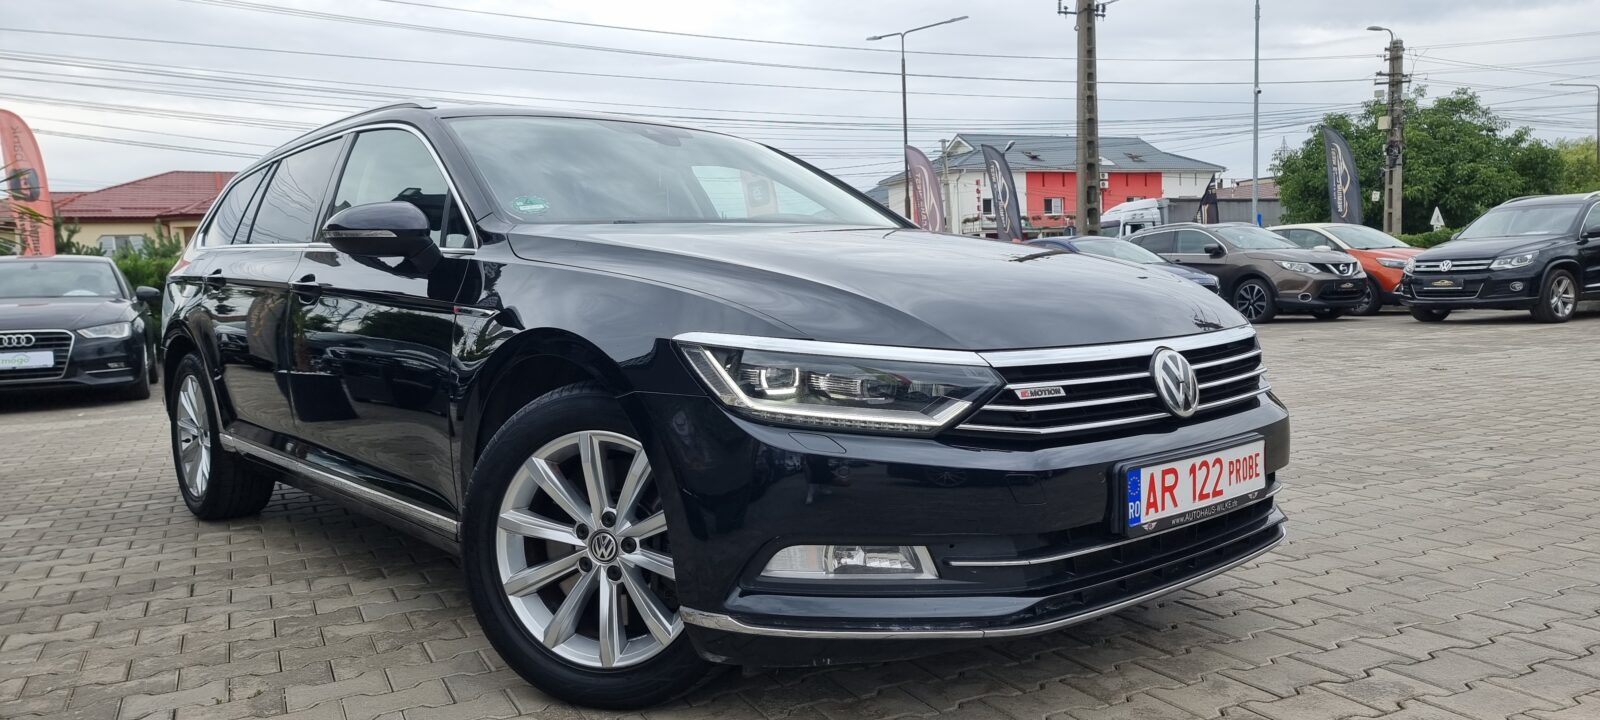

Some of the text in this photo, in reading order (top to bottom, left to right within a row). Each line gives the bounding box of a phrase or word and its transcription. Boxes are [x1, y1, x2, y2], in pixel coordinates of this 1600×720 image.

[1155, 350, 1199, 416] VW
[1128, 501, 1140, 519] RO
[1145, 452, 1260, 516] AR 122 PROBE
